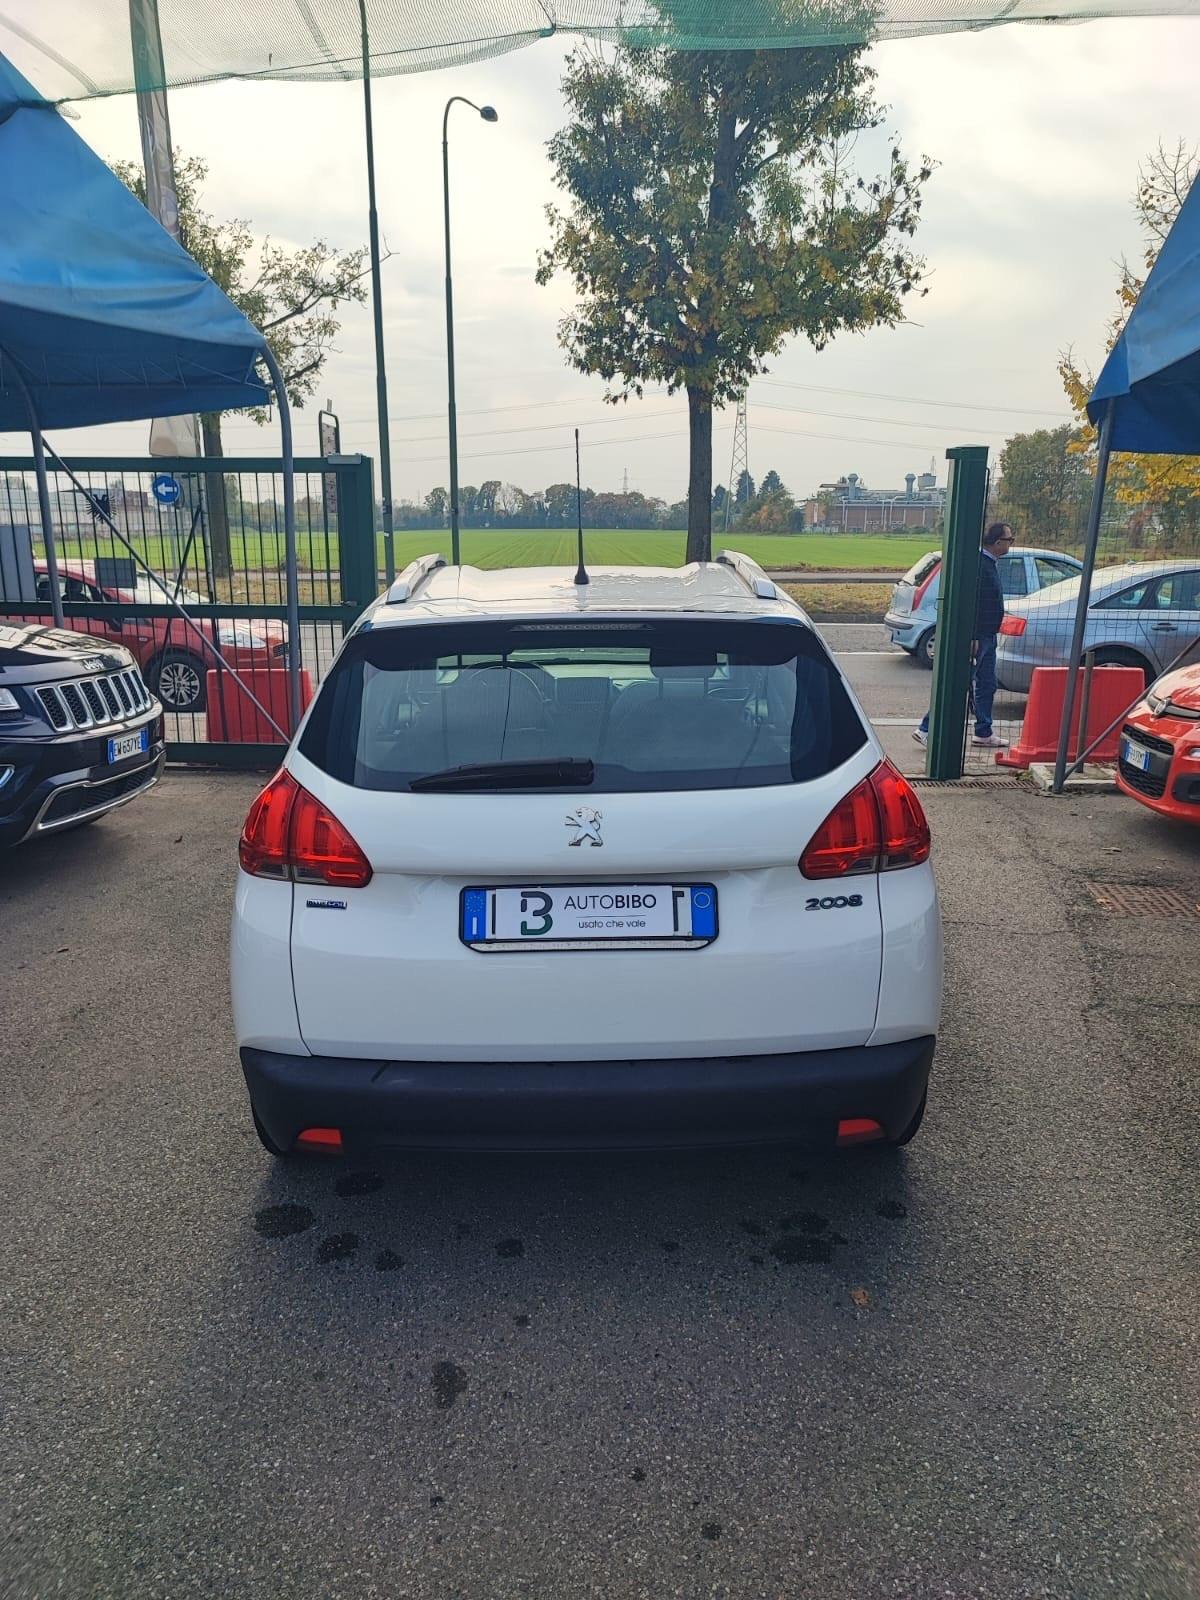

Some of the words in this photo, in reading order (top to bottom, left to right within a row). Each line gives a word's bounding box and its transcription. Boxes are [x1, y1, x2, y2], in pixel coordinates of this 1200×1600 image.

[564, 894, 657, 910] AUTOBIBO
[805, 894, 863, 911] 2008
[578, 920, 604, 929] usato
[605, 920, 624, 928] che
[626, 919, 646, 928] vale
